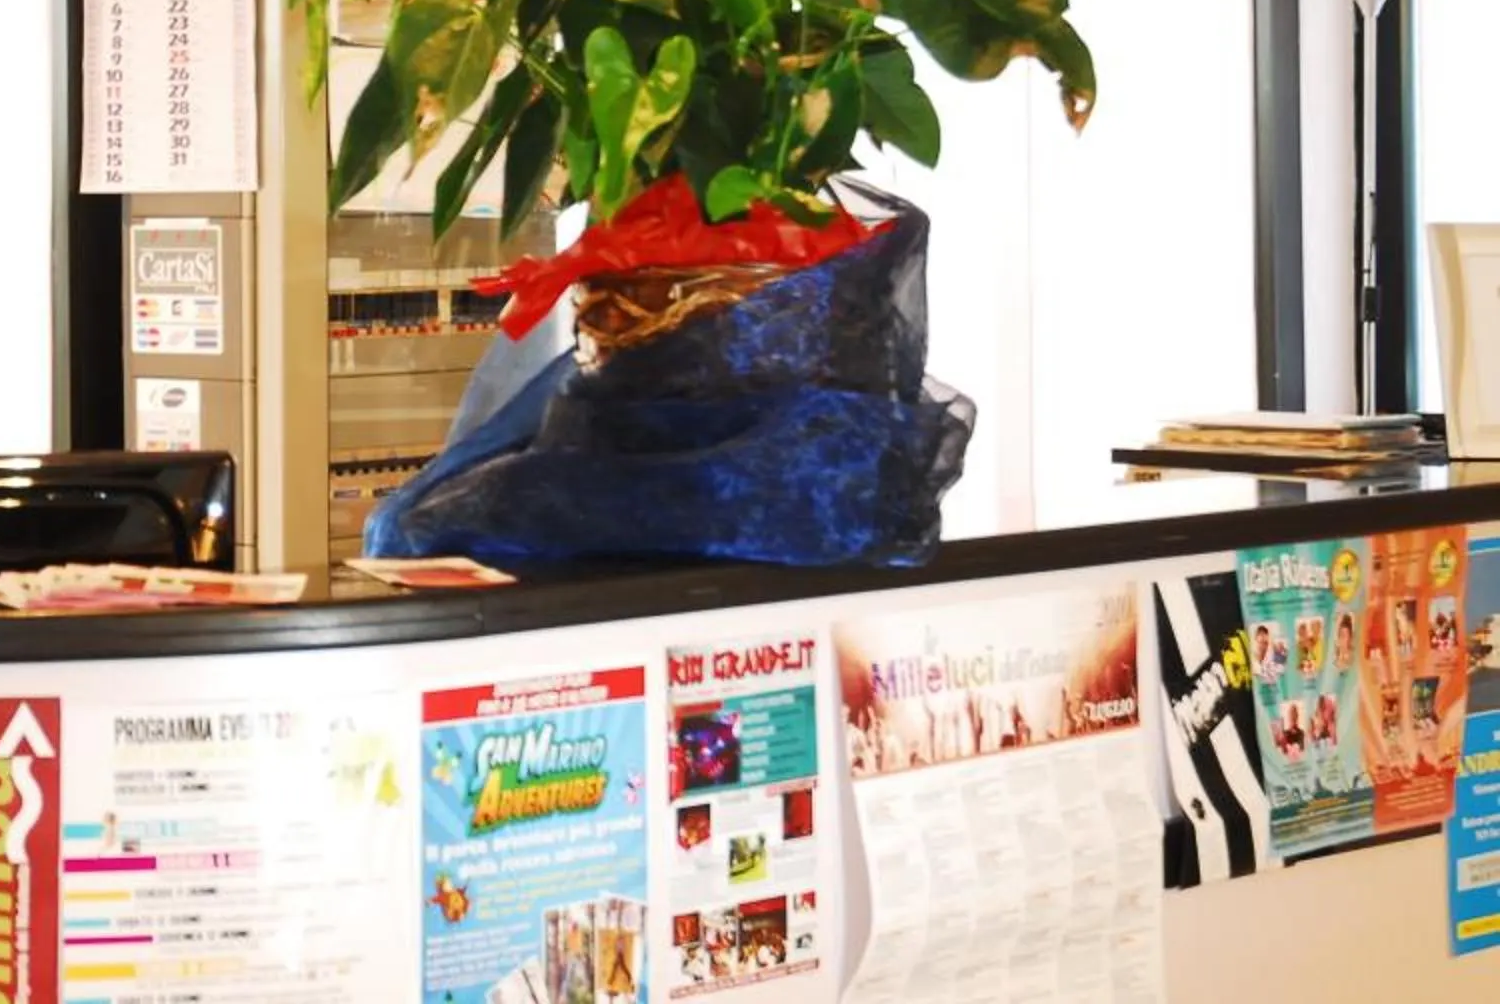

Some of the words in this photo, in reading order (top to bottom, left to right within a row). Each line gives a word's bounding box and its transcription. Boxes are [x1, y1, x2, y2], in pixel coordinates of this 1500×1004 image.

[111, 2, 122, 15] 6
[168, 0, 189, 13] 22
[112, 19, 122, 32] 7
[169, 16, 189, 30] 23
[112, 35, 122, 49] 8
[169, 34, 189, 47] 24
[111, 52, 122, 65] 9
[169, 49, 190, 64] 25
[106, 69, 123, 82] 10
[169, 67, 190, 81] 26
[106, 86, 122, 99] 11
[168, 84, 189, 98] 27
[106, 103, 122, 116] 12
[168, 101, 190, 115] 28
[106, 119, 123, 133] 13
[169, 118, 190, 132] 29
[106, 136, 122, 149] 14
[170, 135, 191, 149] 30
[106, 153, 122, 166] 15
[169, 152, 188, 166] 31
[106, 170, 123, 183] 16
[137, 250, 216, 285] CartaSi
[871, 644, 994, 701] Milleluci
[114, 715, 213, 745] PROGRAMMA
